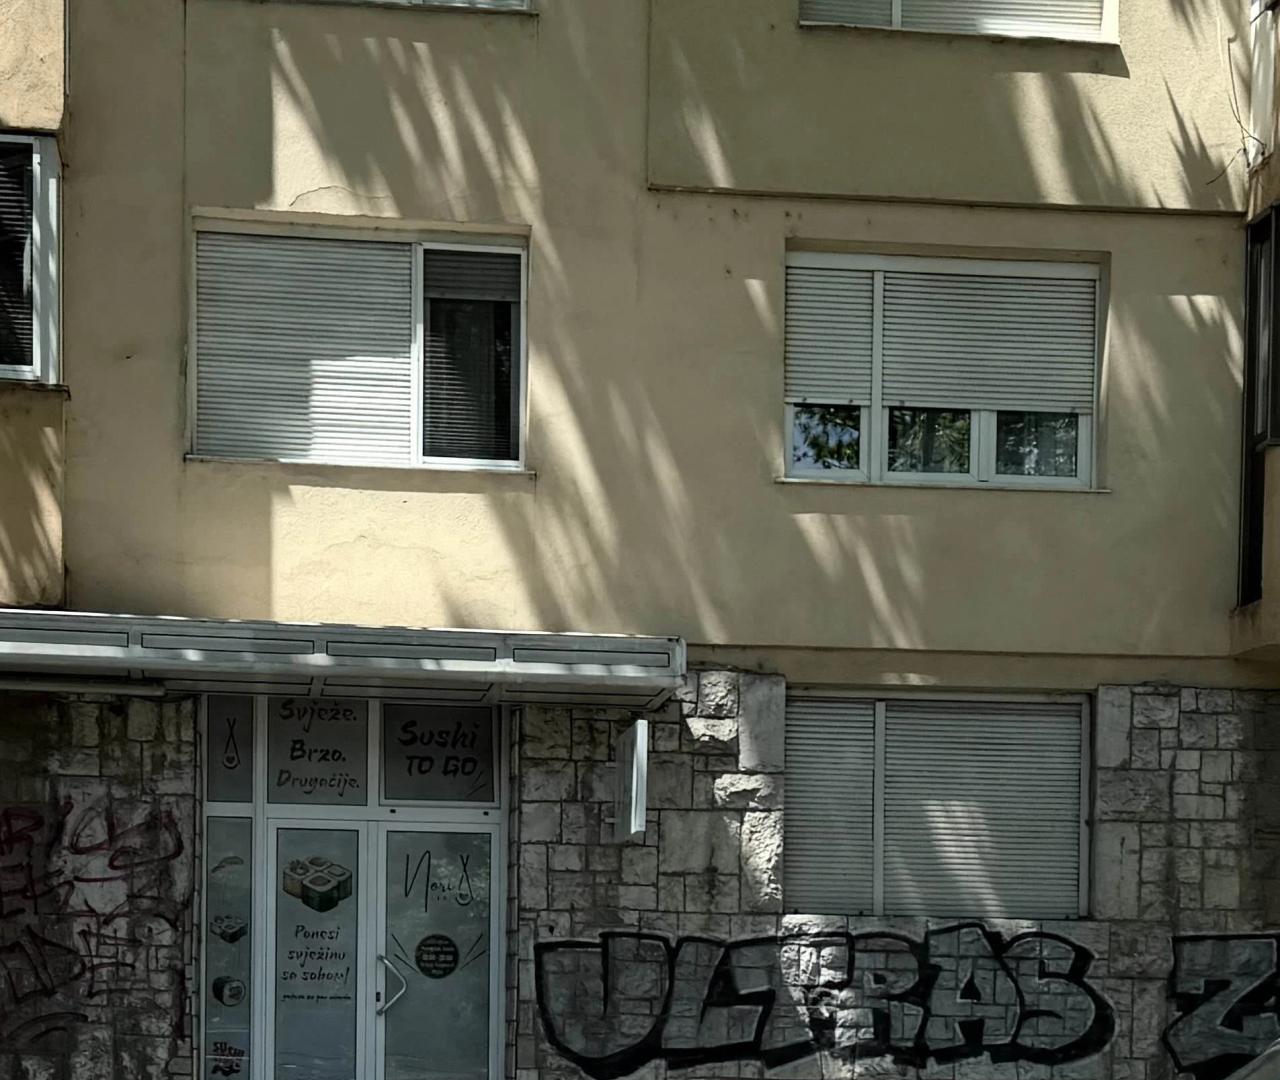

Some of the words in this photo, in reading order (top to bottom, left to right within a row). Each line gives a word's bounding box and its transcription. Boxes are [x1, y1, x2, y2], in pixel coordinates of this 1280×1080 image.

[398, 719, 480, 749] Sushi
[289, 739, 347, 763] Brzo.
[405, 755, 435, 776] TO
[442, 756, 478, 776] GO
